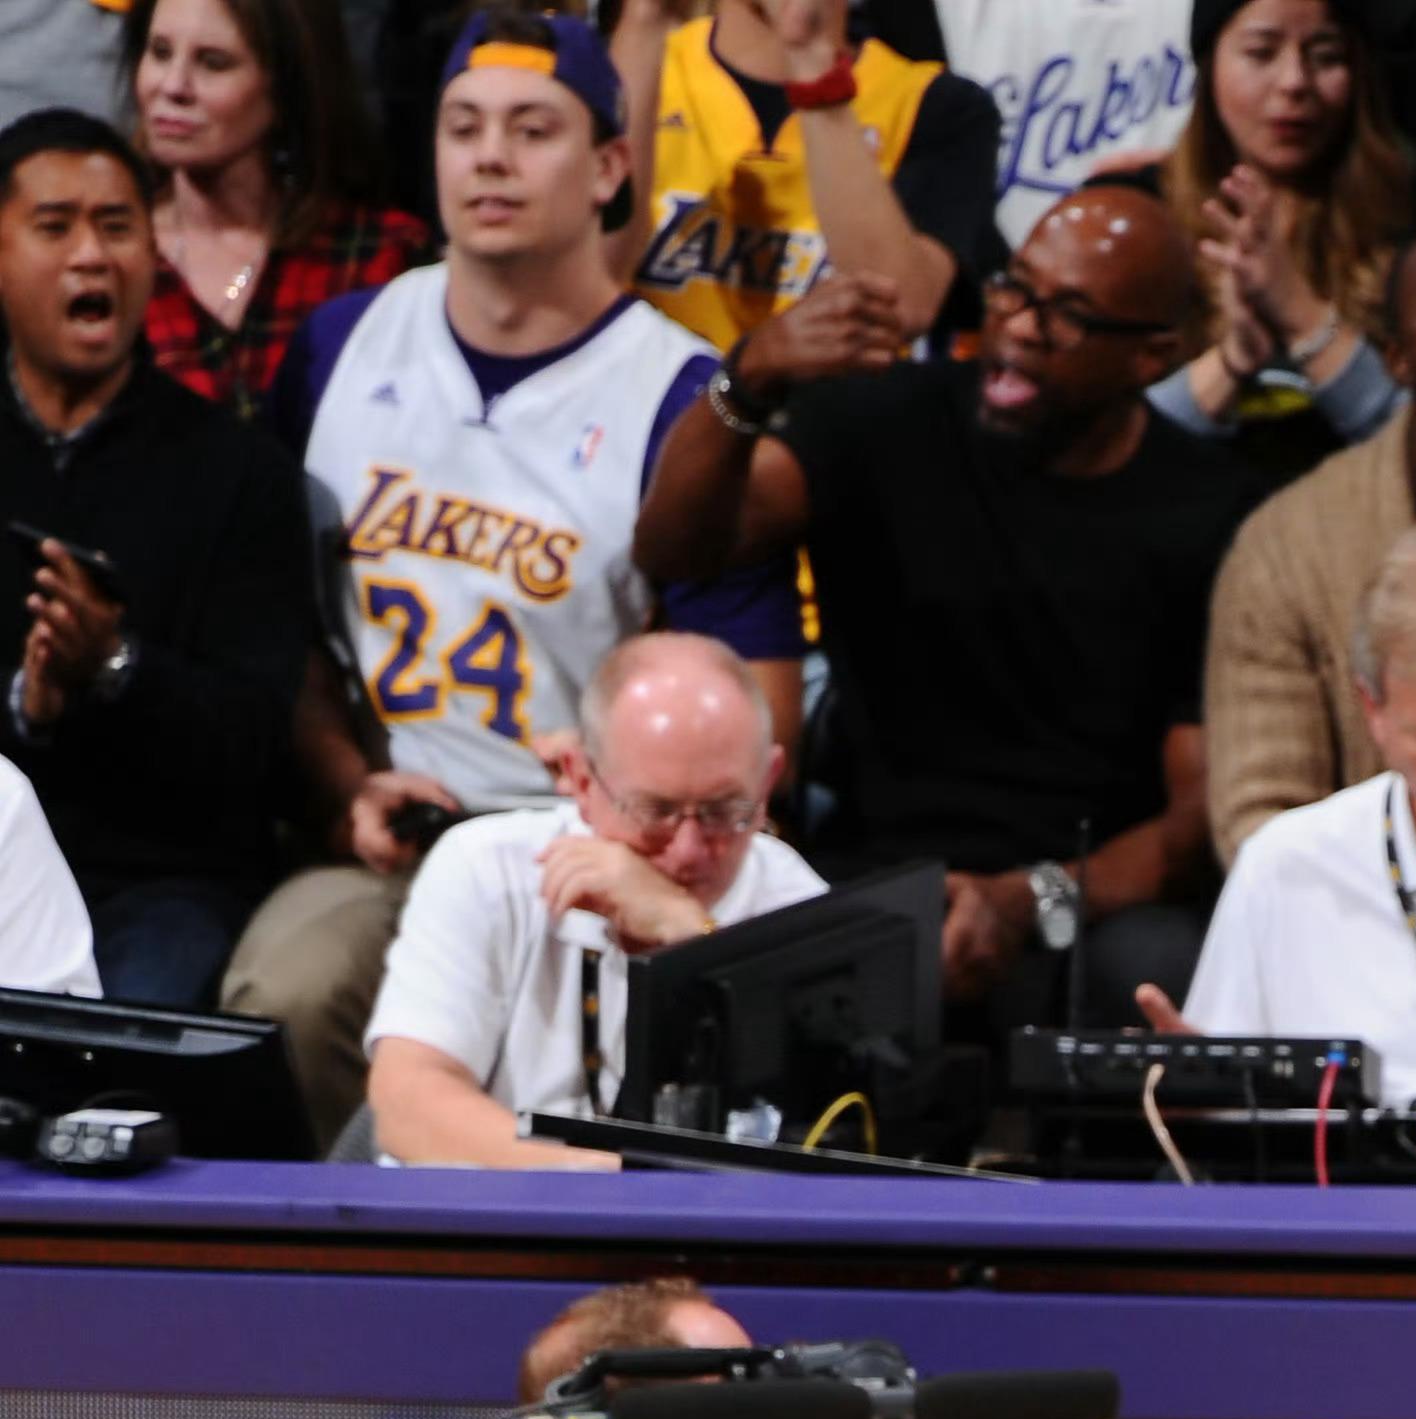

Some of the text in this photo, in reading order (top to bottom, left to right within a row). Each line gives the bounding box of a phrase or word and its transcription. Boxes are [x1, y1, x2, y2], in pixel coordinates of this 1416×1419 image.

[985, 44, 1197, 198] Laker
[344, 466, 583, 604] LAKERS
[362, 576, 532, 745] 24
